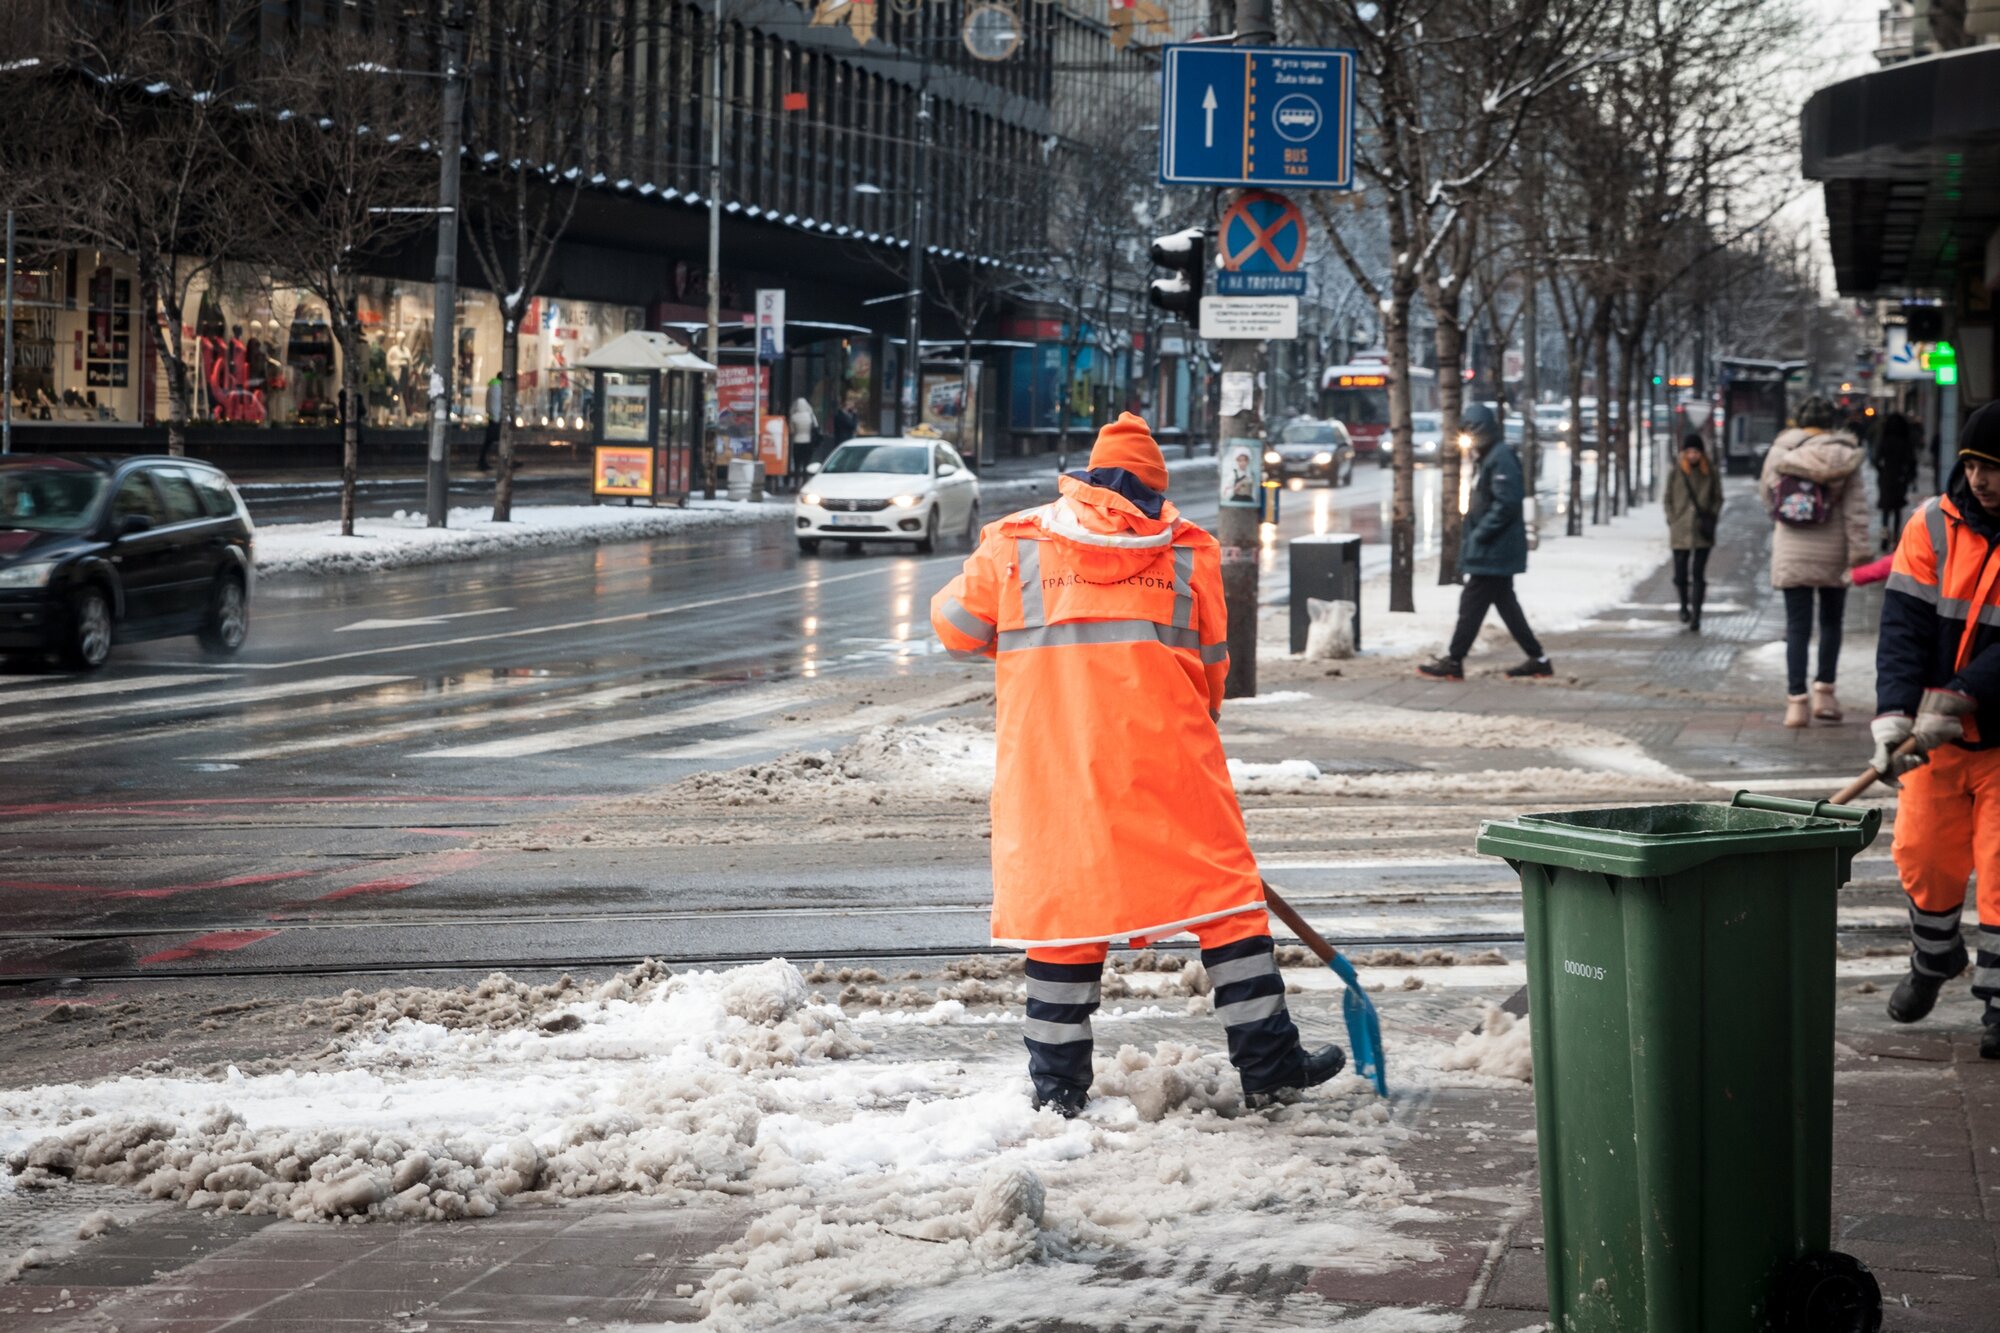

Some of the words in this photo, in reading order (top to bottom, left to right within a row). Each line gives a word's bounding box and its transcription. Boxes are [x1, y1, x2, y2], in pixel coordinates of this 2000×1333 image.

[1283, 148, 1308, 162] BUS
[1283, 164, 1309, 176] TAXI
[1042, 574, 1101, 590] ГРАДС
[1110, 575, 1174, 591] ИСТОЋА
